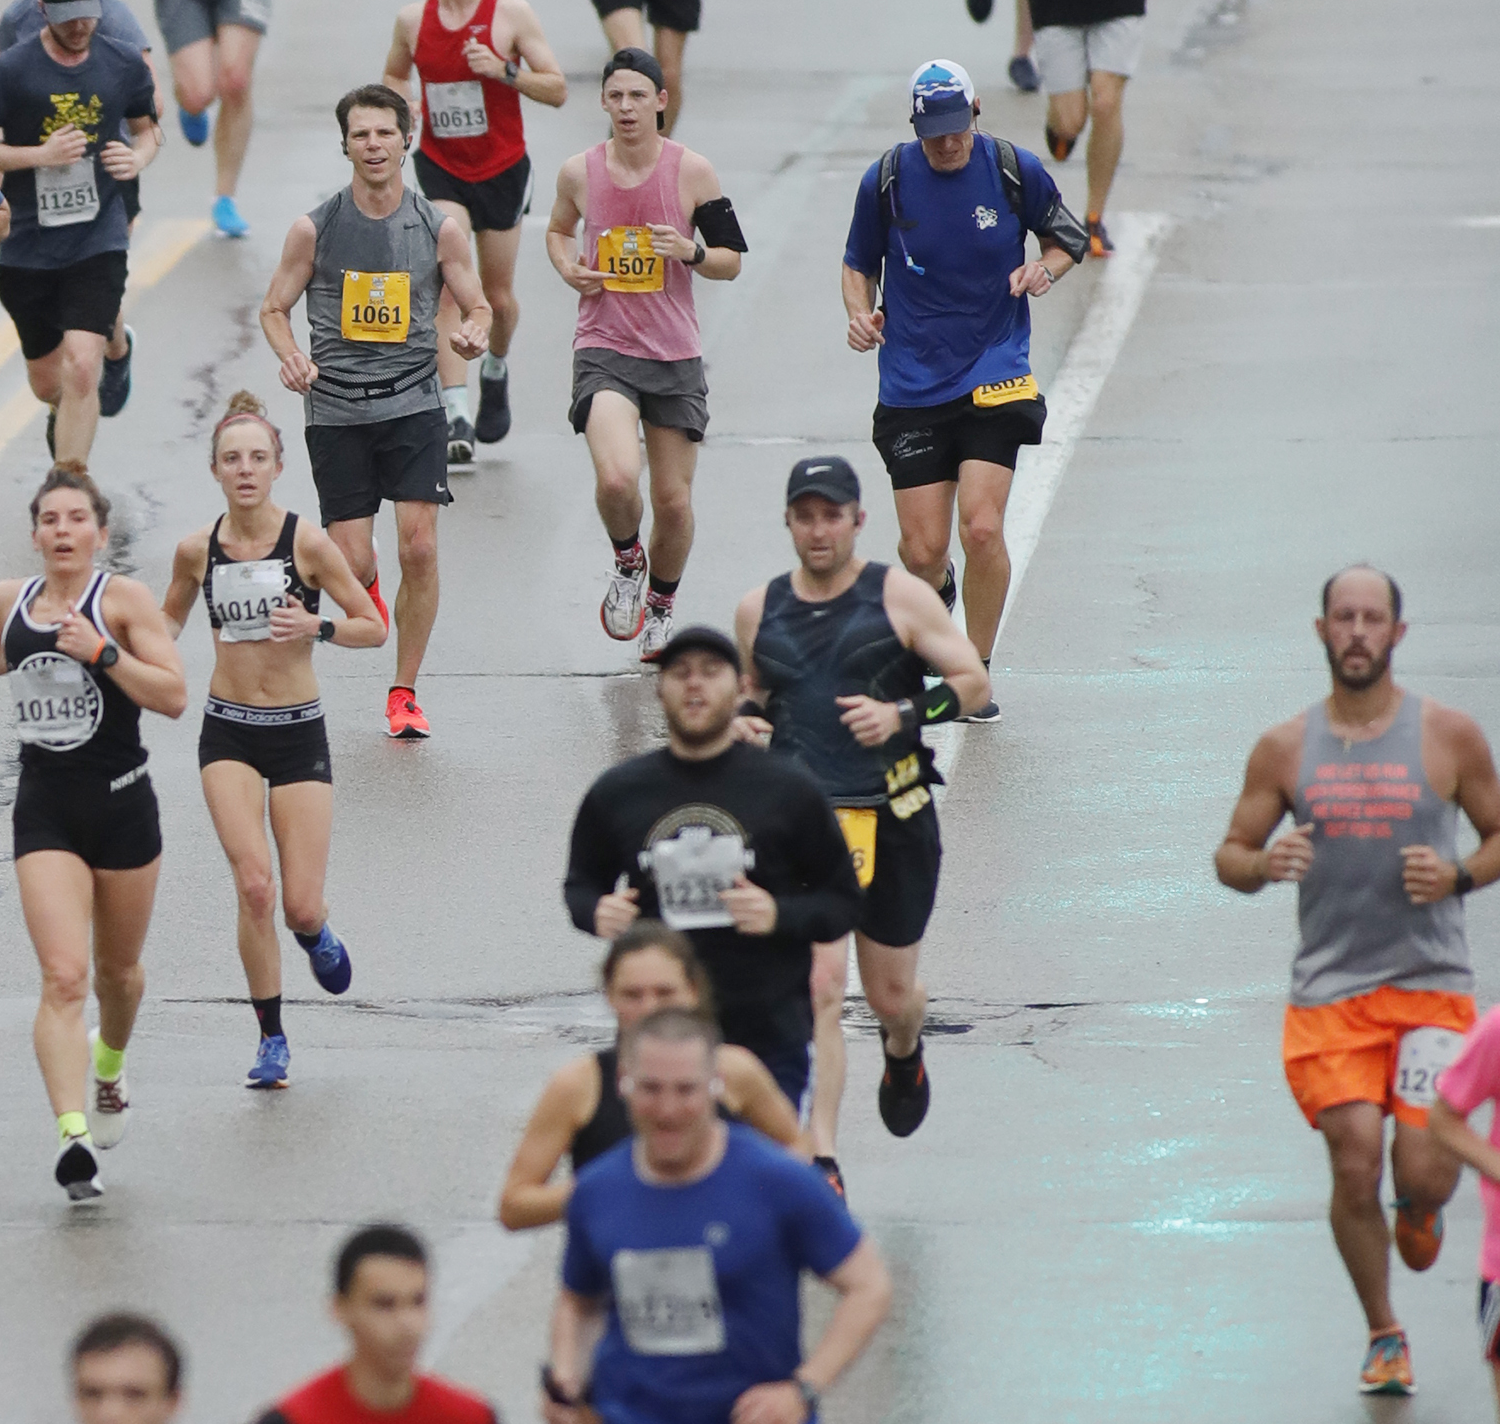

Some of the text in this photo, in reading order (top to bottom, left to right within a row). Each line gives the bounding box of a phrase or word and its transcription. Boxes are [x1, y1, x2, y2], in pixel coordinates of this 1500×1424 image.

[431, 108, 485, 128] 10613
[39, 186, 98, 211] 11251
[607, 256, 657, 275] 1507
[351, 304, 403, 325] 1061
[16, 696, 87, 723] 10148
[221, 706, 246, 720] new
[245, 708, 294, 724] balance
